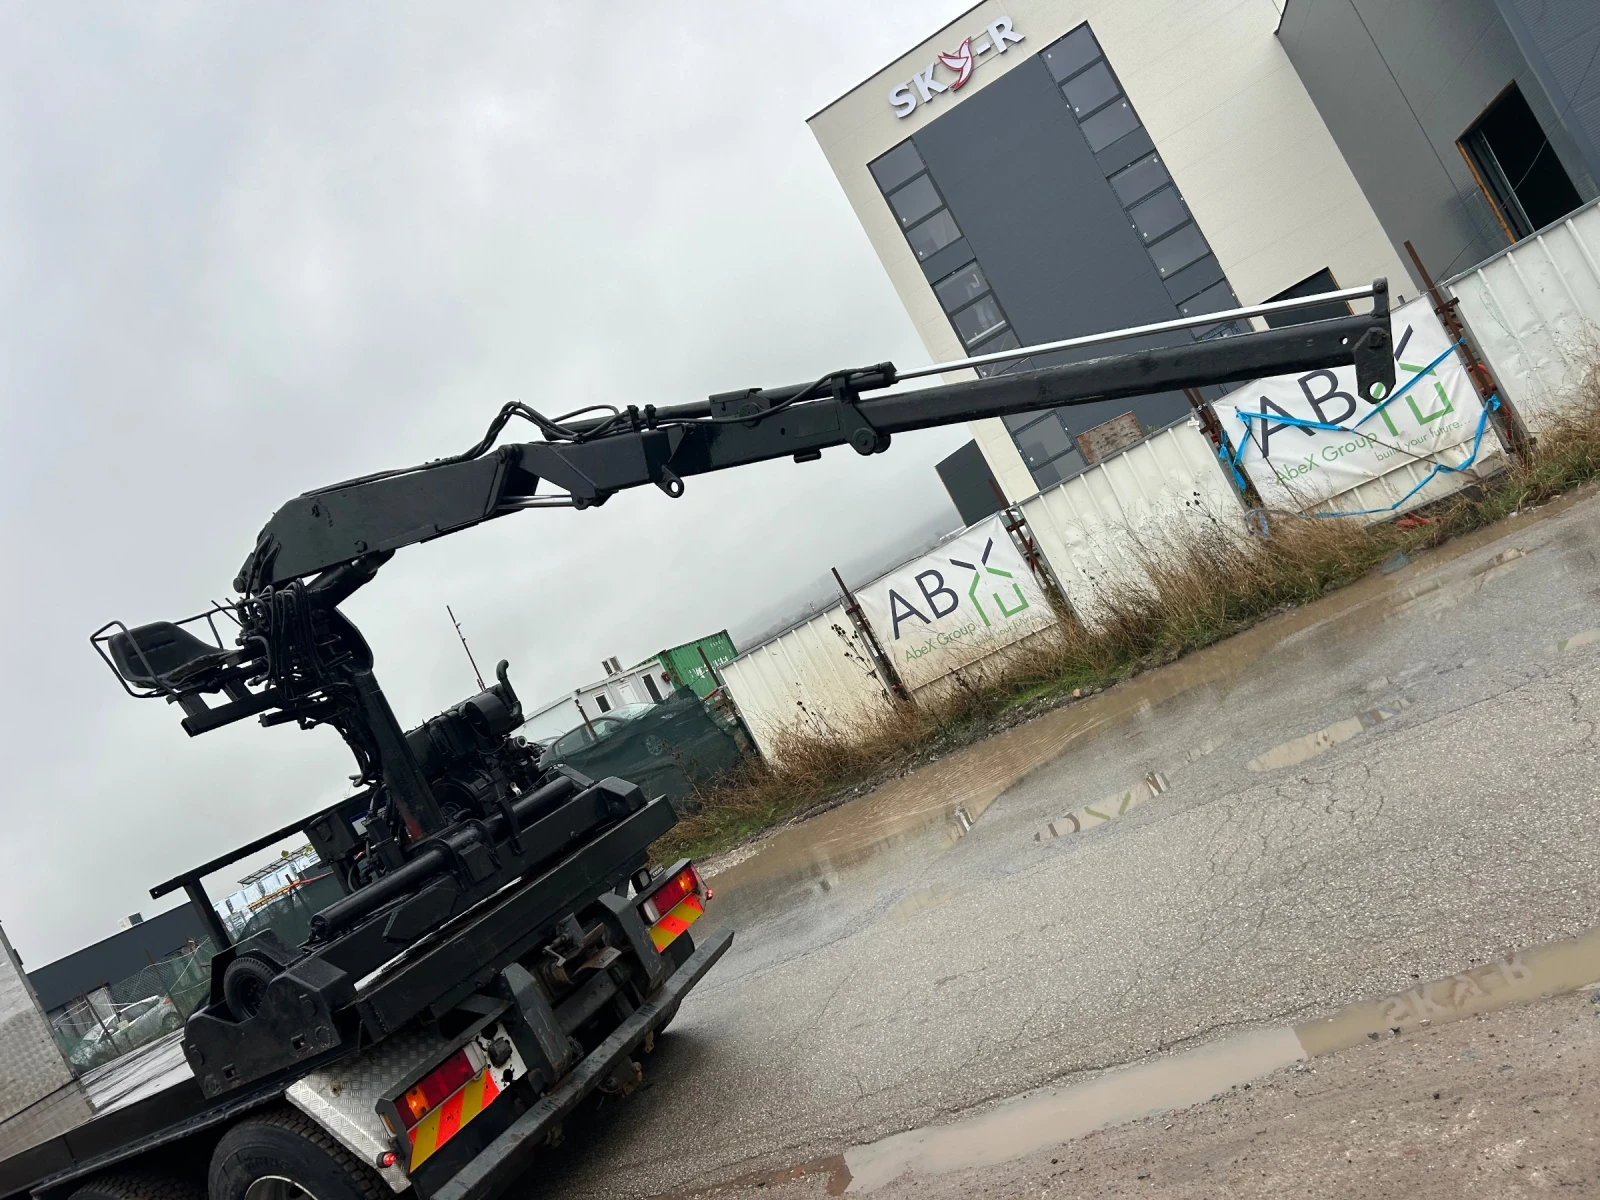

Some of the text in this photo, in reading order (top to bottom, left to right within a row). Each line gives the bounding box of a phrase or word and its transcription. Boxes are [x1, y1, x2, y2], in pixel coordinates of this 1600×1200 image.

[1276, 432, 1378, 485] AbeX Group
[1374, 441, 1402, 462] build
[1404, 433, 1429, 452] your
[905, 637, 937, 663] AbeX
[936, 622, 976, 646] Group
